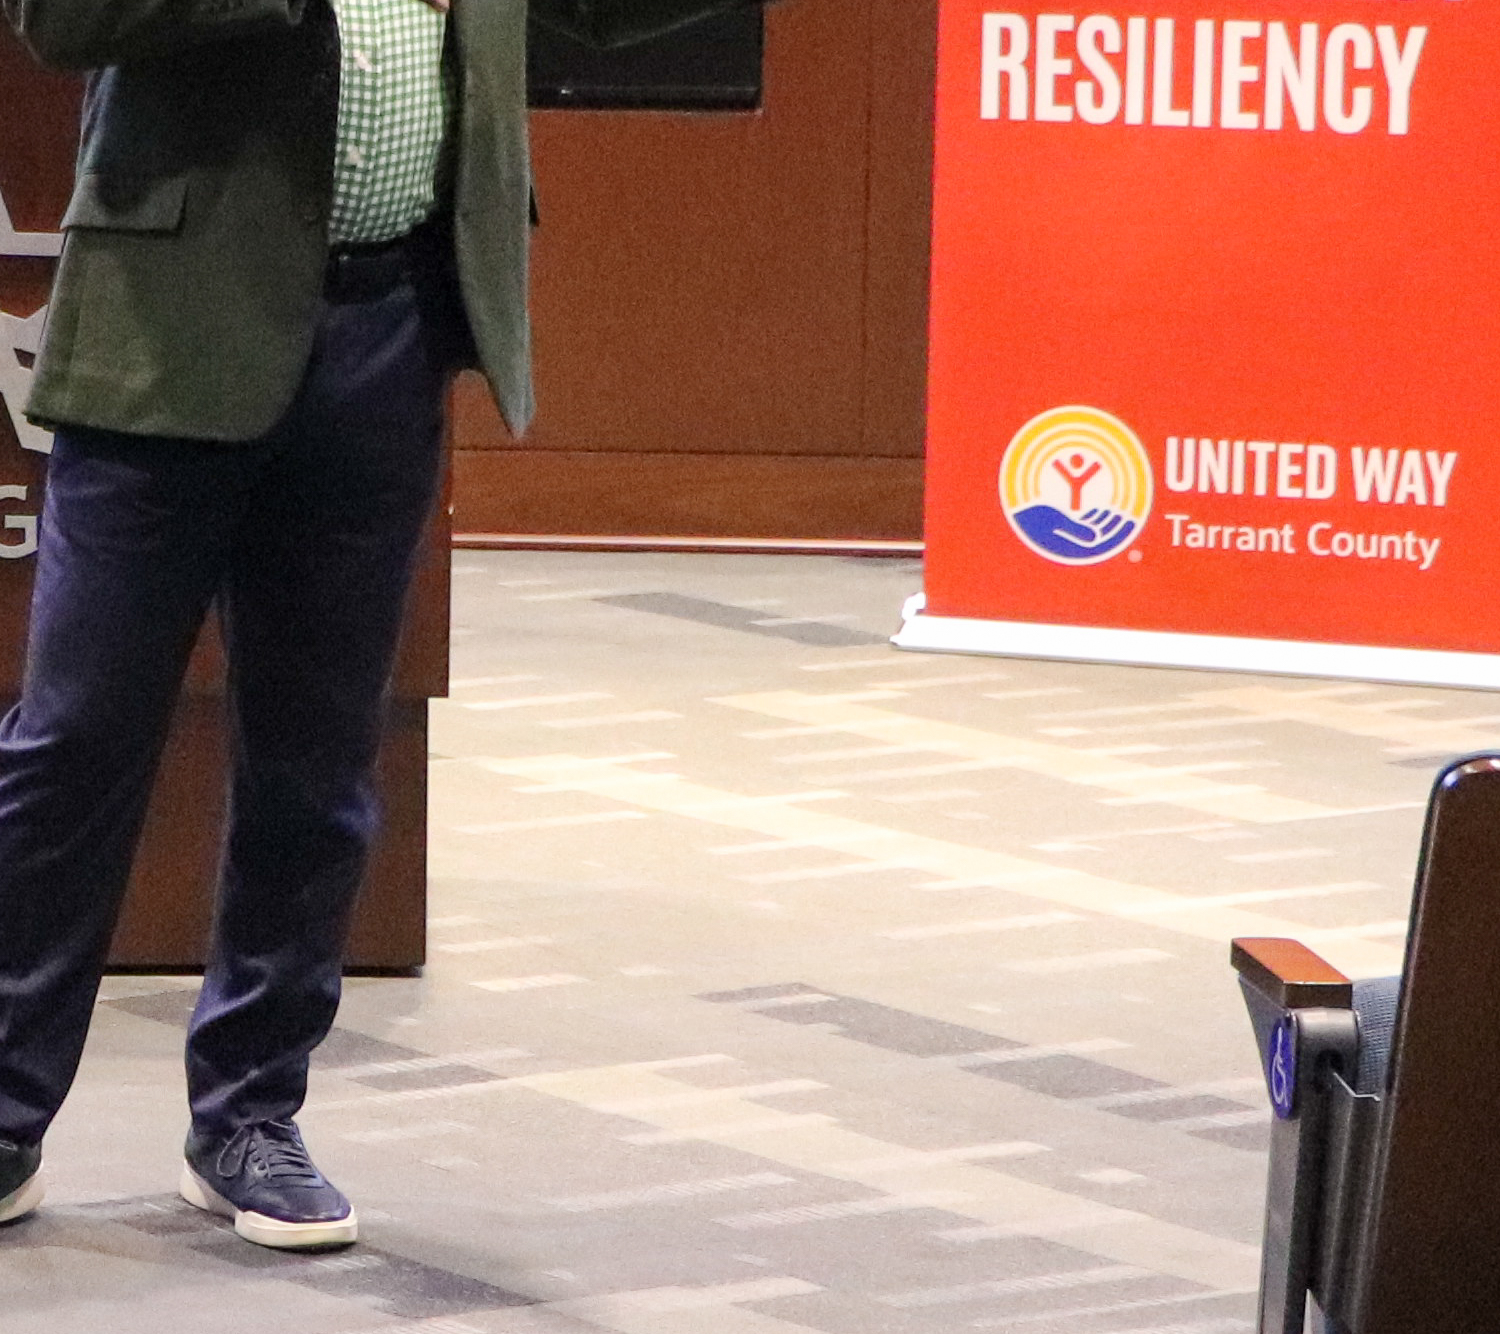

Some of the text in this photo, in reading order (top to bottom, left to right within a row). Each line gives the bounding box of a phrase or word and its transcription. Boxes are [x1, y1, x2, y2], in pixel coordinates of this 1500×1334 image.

[981, 13, 1427, 135] RESILIENCY
[1166, 437, 1457, 506] UNITED WAY
[1165, 514, 1440, 570] Tarrant County
